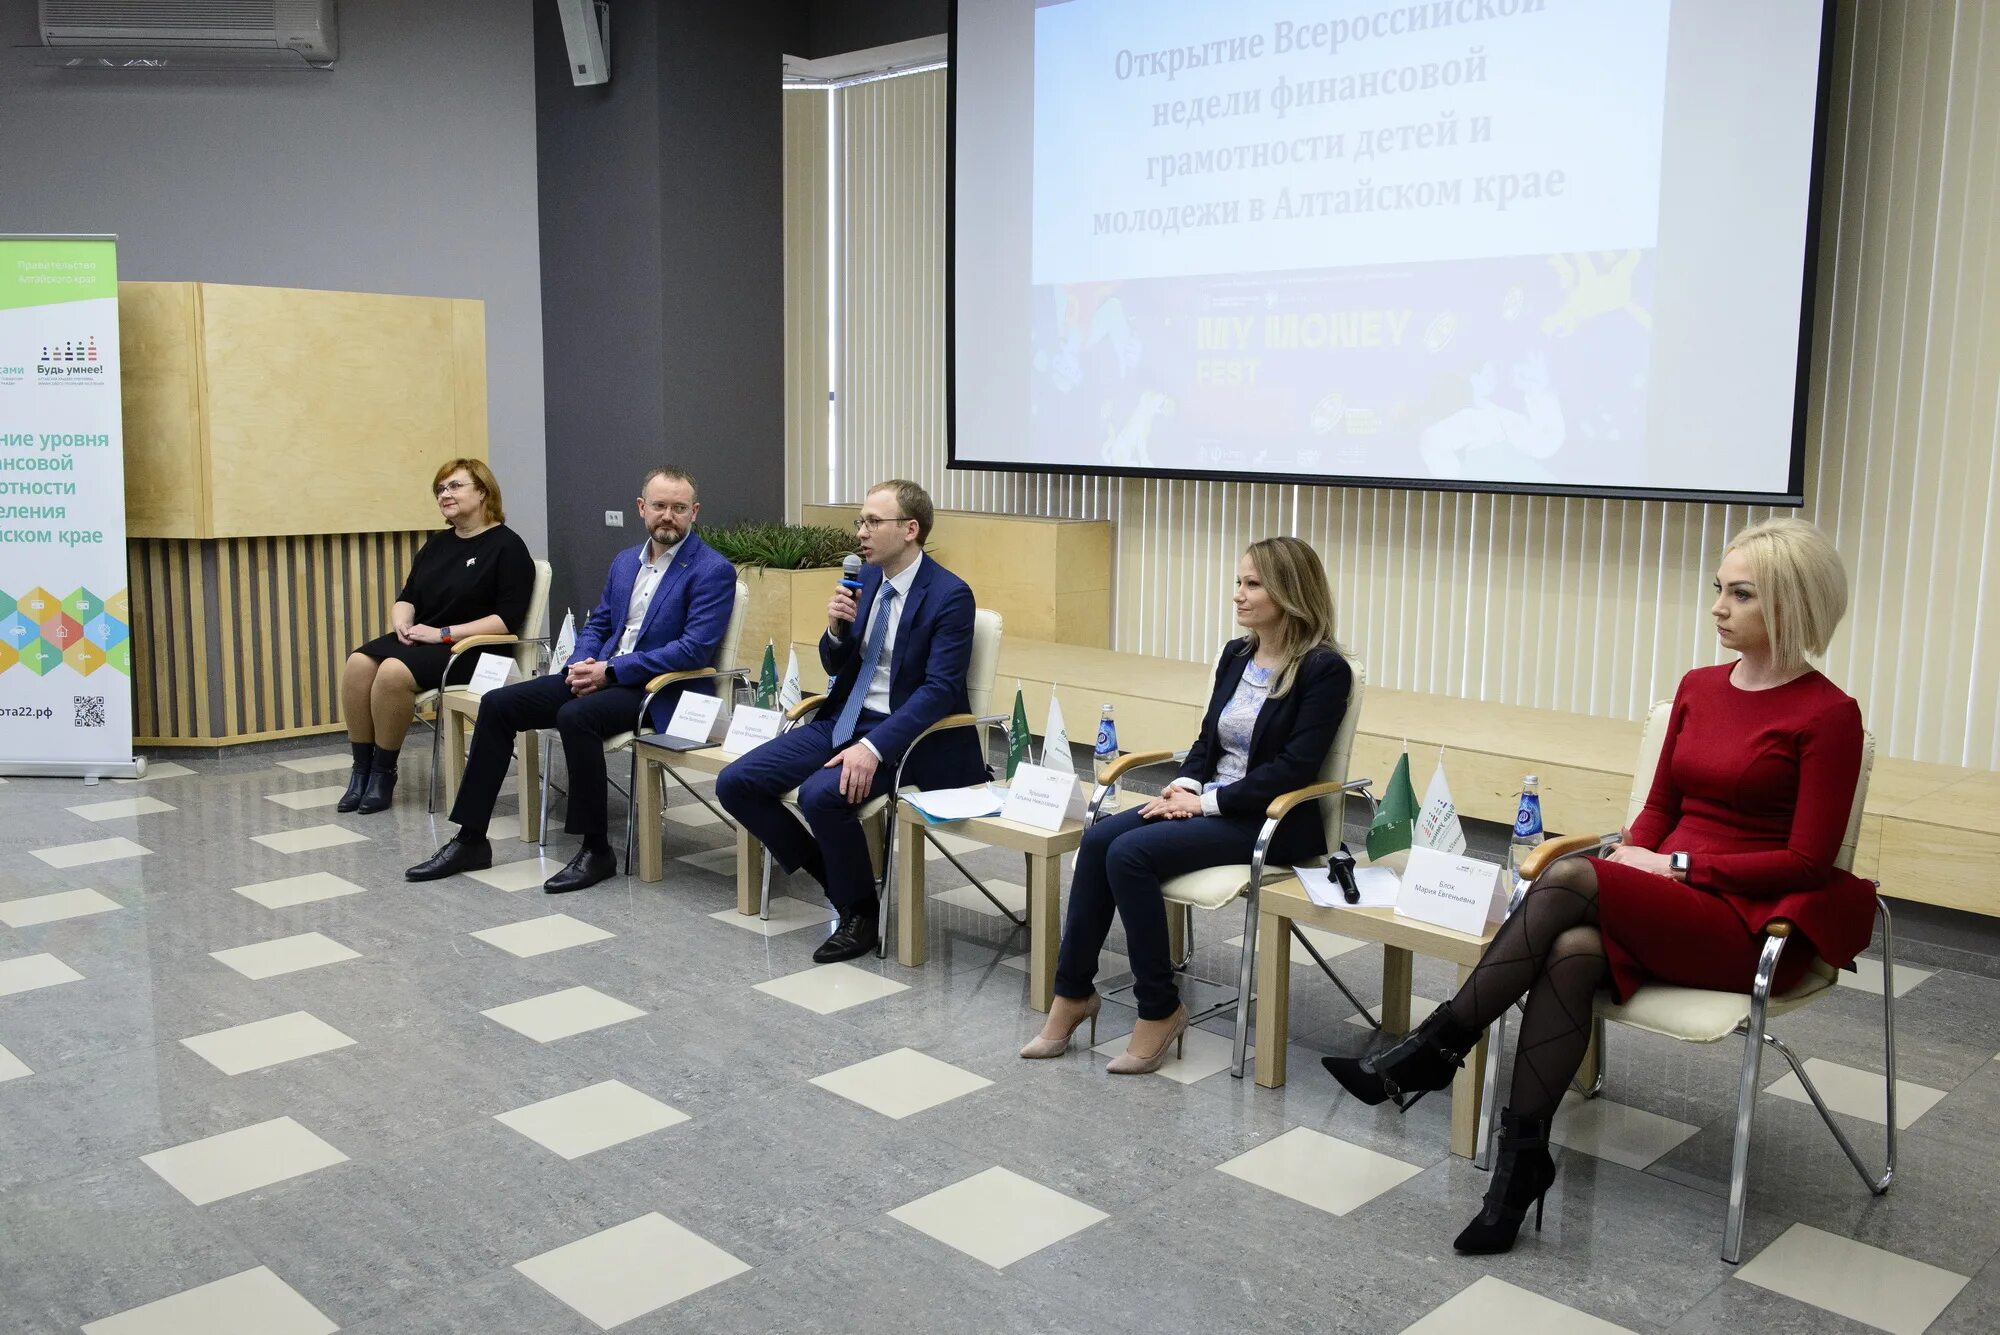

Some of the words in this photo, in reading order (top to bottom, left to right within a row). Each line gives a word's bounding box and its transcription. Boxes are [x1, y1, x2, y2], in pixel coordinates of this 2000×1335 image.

[1115, 33, 1264, 81] Открытие
[1152, 88, 1262, 129] недели
[1270, 45, 1487, 119] финансовой
[1145, 133, 1345, 187] грамотности
[1353, 109, 1459, 163] детей
[1469, 115, 1493, 143] и
[1092, 200, 1241, 237] молодежи
[1247, 198, 1265, 222] в
[1272, 177, 1463, 220] Алтайском
[1472, 168, 1566, 212] крае
[1197, 315, 1253, 351] MY
[1265, 309, 1412, 350] MONEY
[37, 365, 64, 376] Будь
[66, 365, 103, 376] умнее!
[1197, 358, 1262, 387] FEST
[39, 434, 109, 451] уровня
[0, 453, 73, 471] нсовой
[0, 482, 76, 495] отности
[0, 525, 52, 543] ском
[58, 530, 103, 548] крае
[1414, 884, 1437, 895] Мария
[1438, 890, 1476, 905] Евгеньевна
[1439, 880, 1456, 891] Блок
